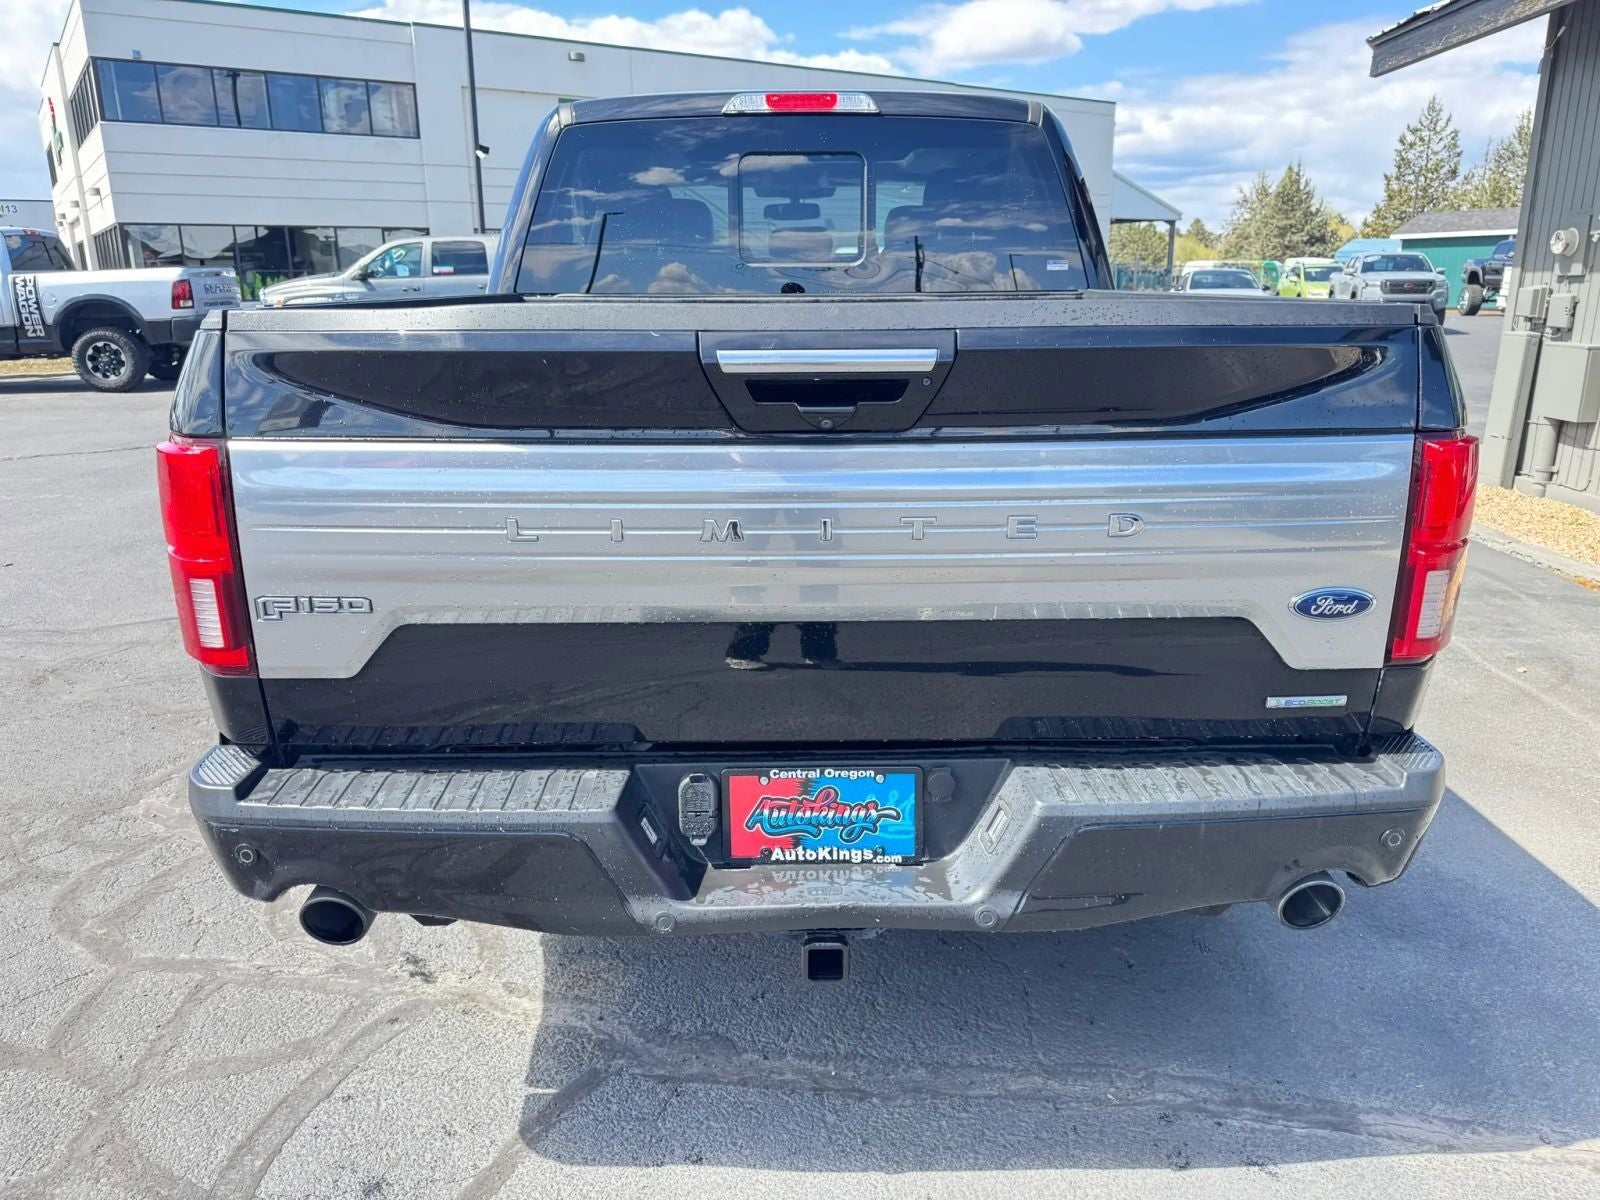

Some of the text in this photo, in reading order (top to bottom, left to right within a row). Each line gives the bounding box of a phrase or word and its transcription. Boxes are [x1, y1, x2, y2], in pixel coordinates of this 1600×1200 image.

[15, 276, 37, 338] WAGON
[26, 275, 46, 337] POWER
[505, 514, 1147, 543] LIMITED
[1310, 595, 1359, 616] Ford
[769, 768, 875, 780] Central Oregon
[771, 846, 903, 864] AutoKings.com
